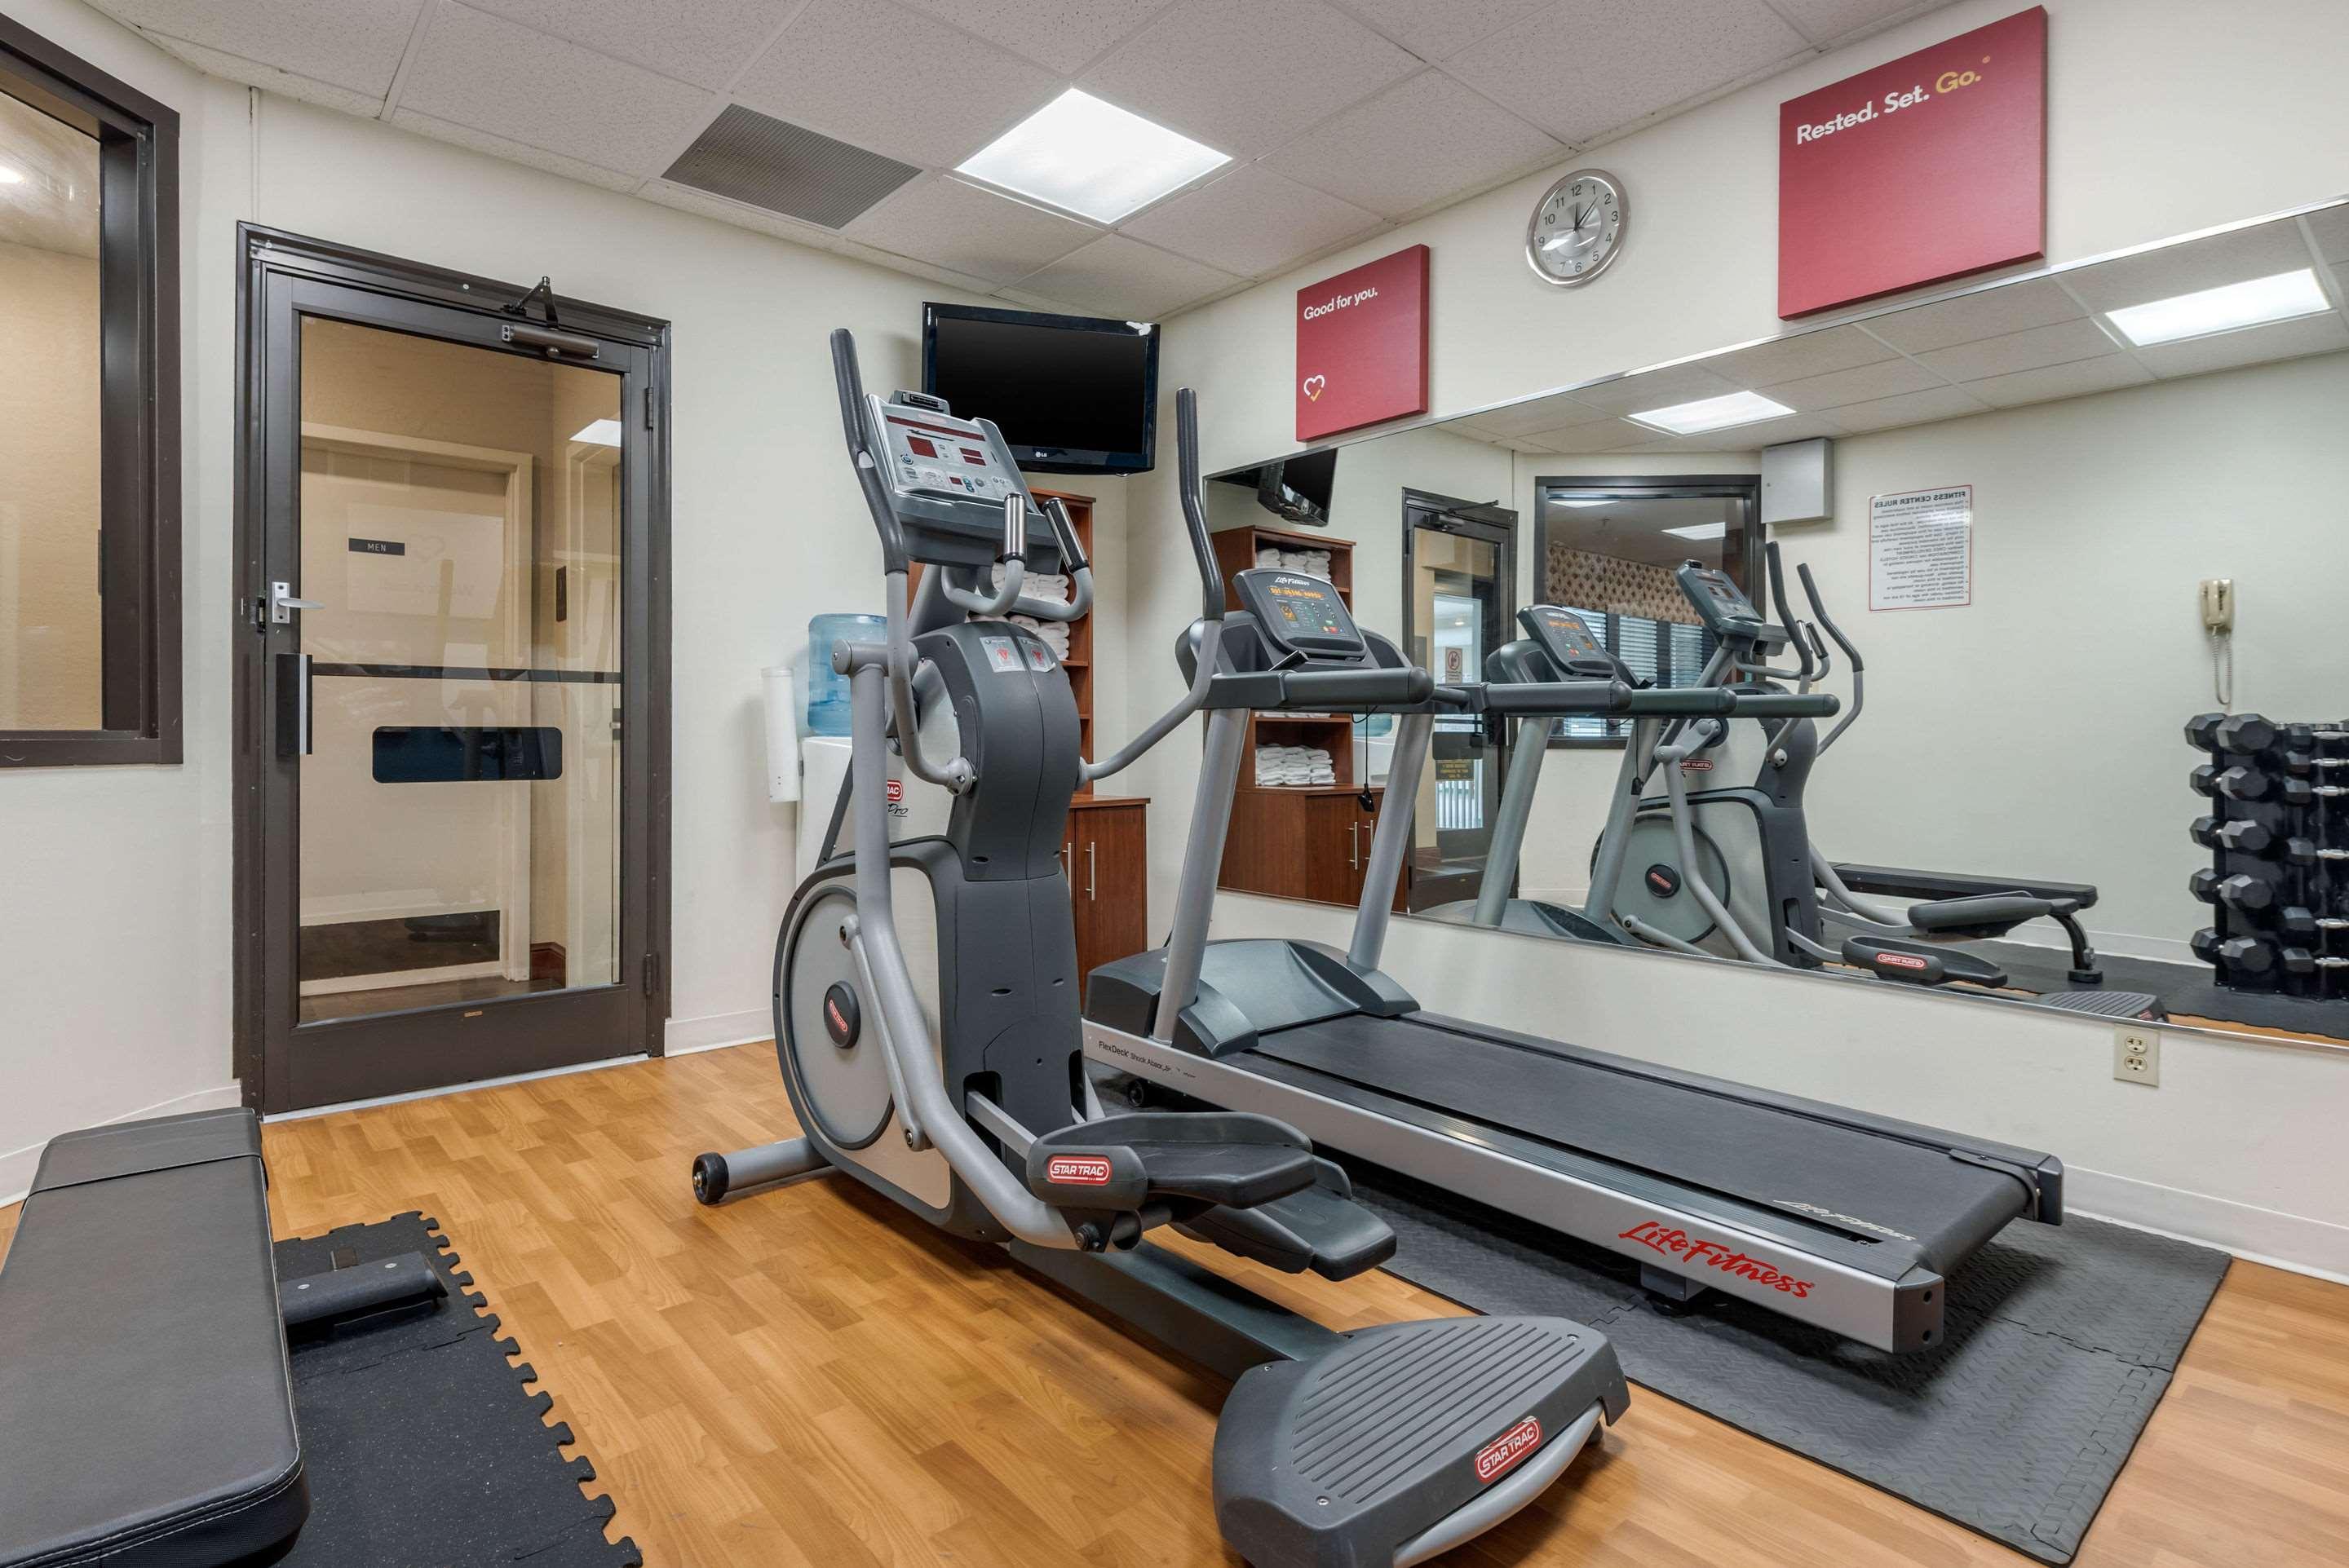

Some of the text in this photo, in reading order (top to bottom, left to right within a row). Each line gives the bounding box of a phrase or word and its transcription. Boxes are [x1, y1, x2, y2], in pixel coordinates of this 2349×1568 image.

[1797, 71, 1981, 144] Rested. Set. Go.
[1571, 184, 1581, 197] 12
[1592, 184, 1596, 195] 1
[1555, 197, 1564, 209] 11
[1604, 193, 1612, 205] 2
[1545, 214, 1555, 225] 10
[1611, 210, 1618, 222] 3
[1605, 232, 1612, 243] 4
[1592, 250, 1599, 262] 5
[1575, 262, 1581, 272] 6
[1303, 287, 1378, 320] Good for you.
[367, 543, 387, 552] MEN
[1052, 1164, 1104, 1176] STAR TRAC
[1481, 1426, 1534, 1473] STAR TRAC
